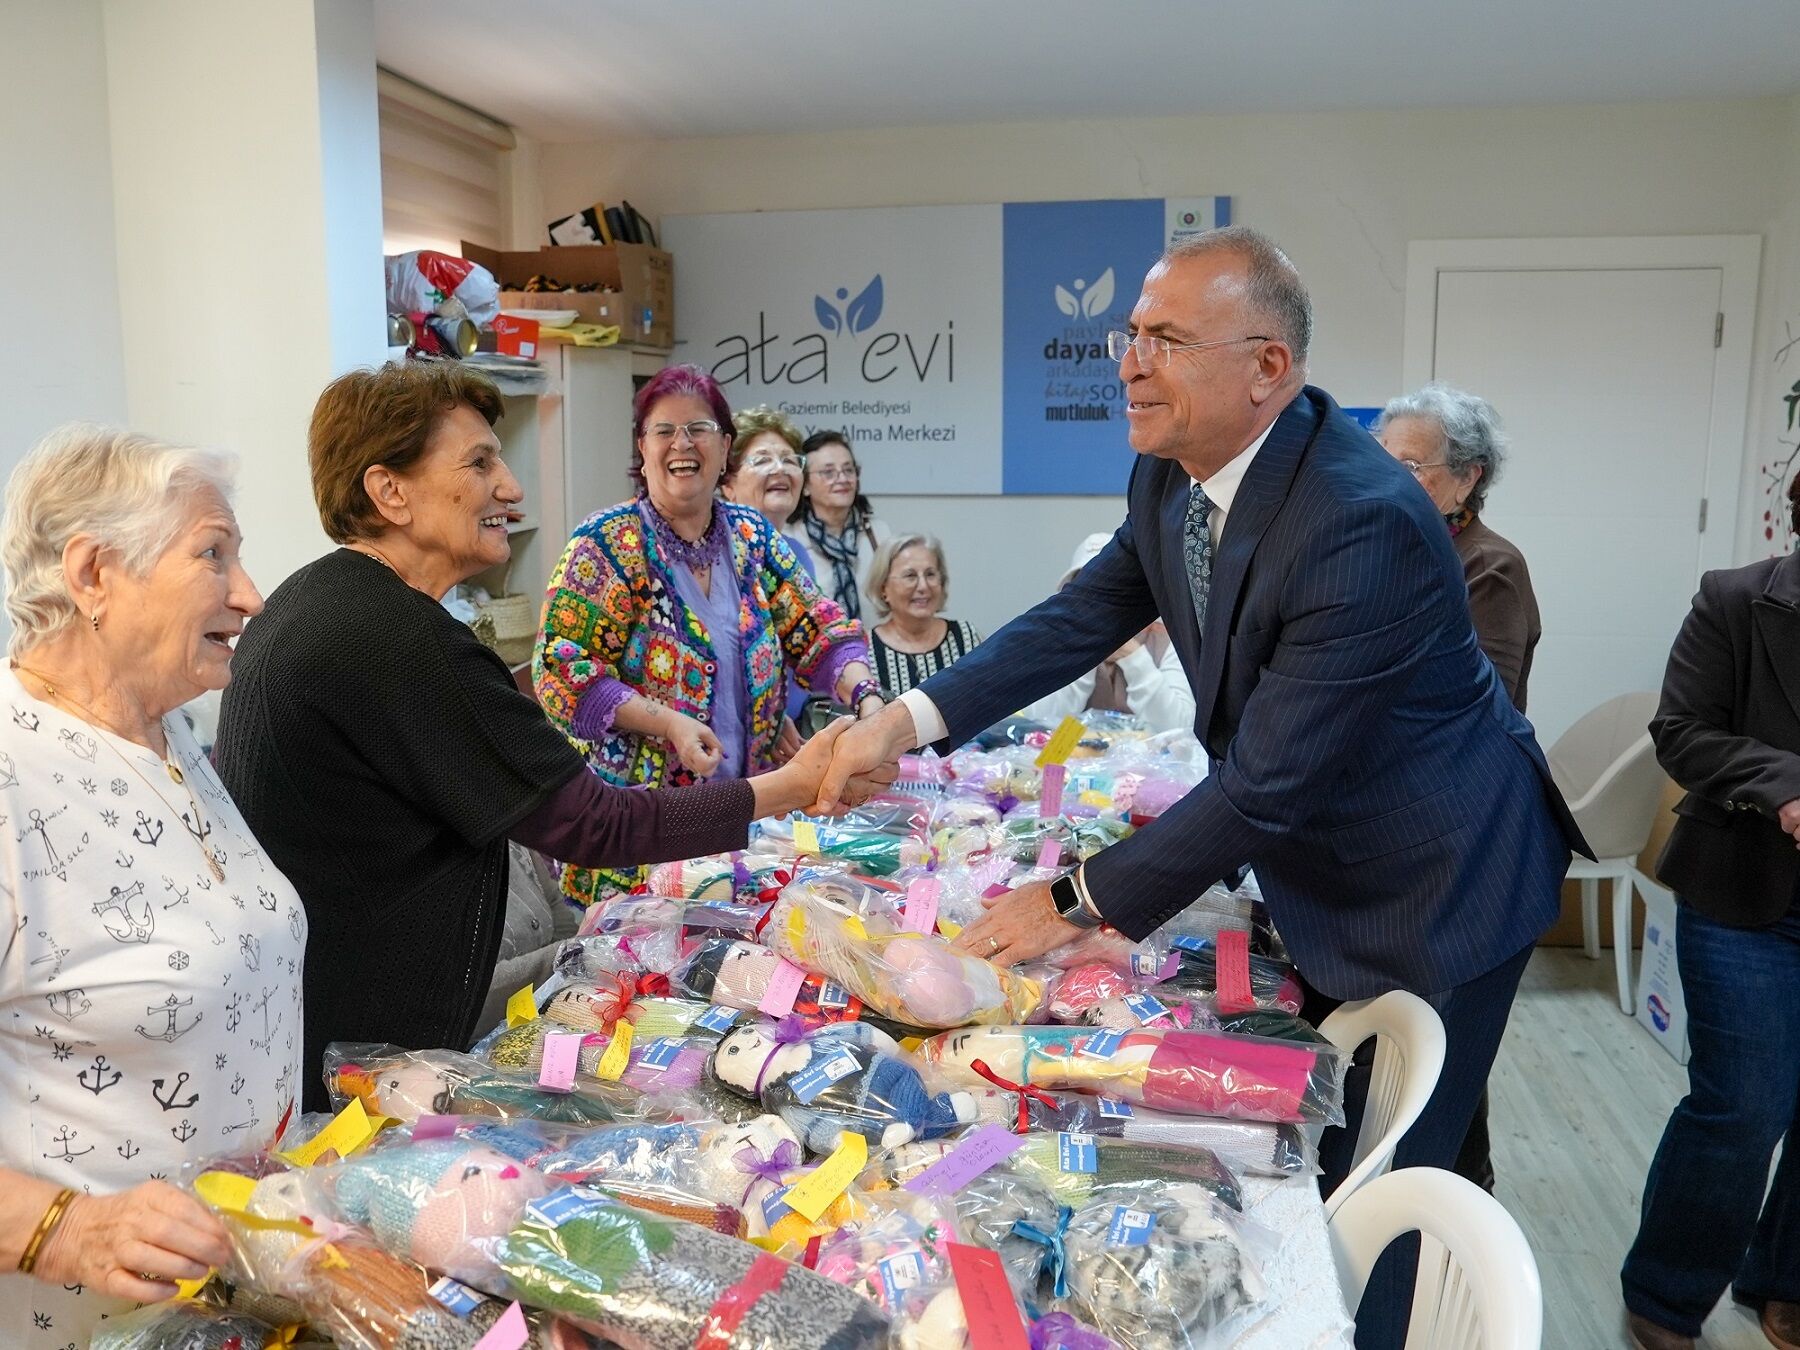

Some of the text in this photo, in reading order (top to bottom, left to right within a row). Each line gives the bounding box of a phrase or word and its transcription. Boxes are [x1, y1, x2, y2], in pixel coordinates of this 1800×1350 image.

[1063, 323, 1107, 342] payl
[711, 311, 954, 385] ata evi
[778, 400, 911, 418] Gaziemir Belediyesi
[1045, 402, 1109, 421] mutluluk
[841, 424, 883, 441] Alma
[889, 424, 956, 441] Merkezi
[790, 1076, 804, 1086] Ata
[804, 1067, 815, 1078] Evi
